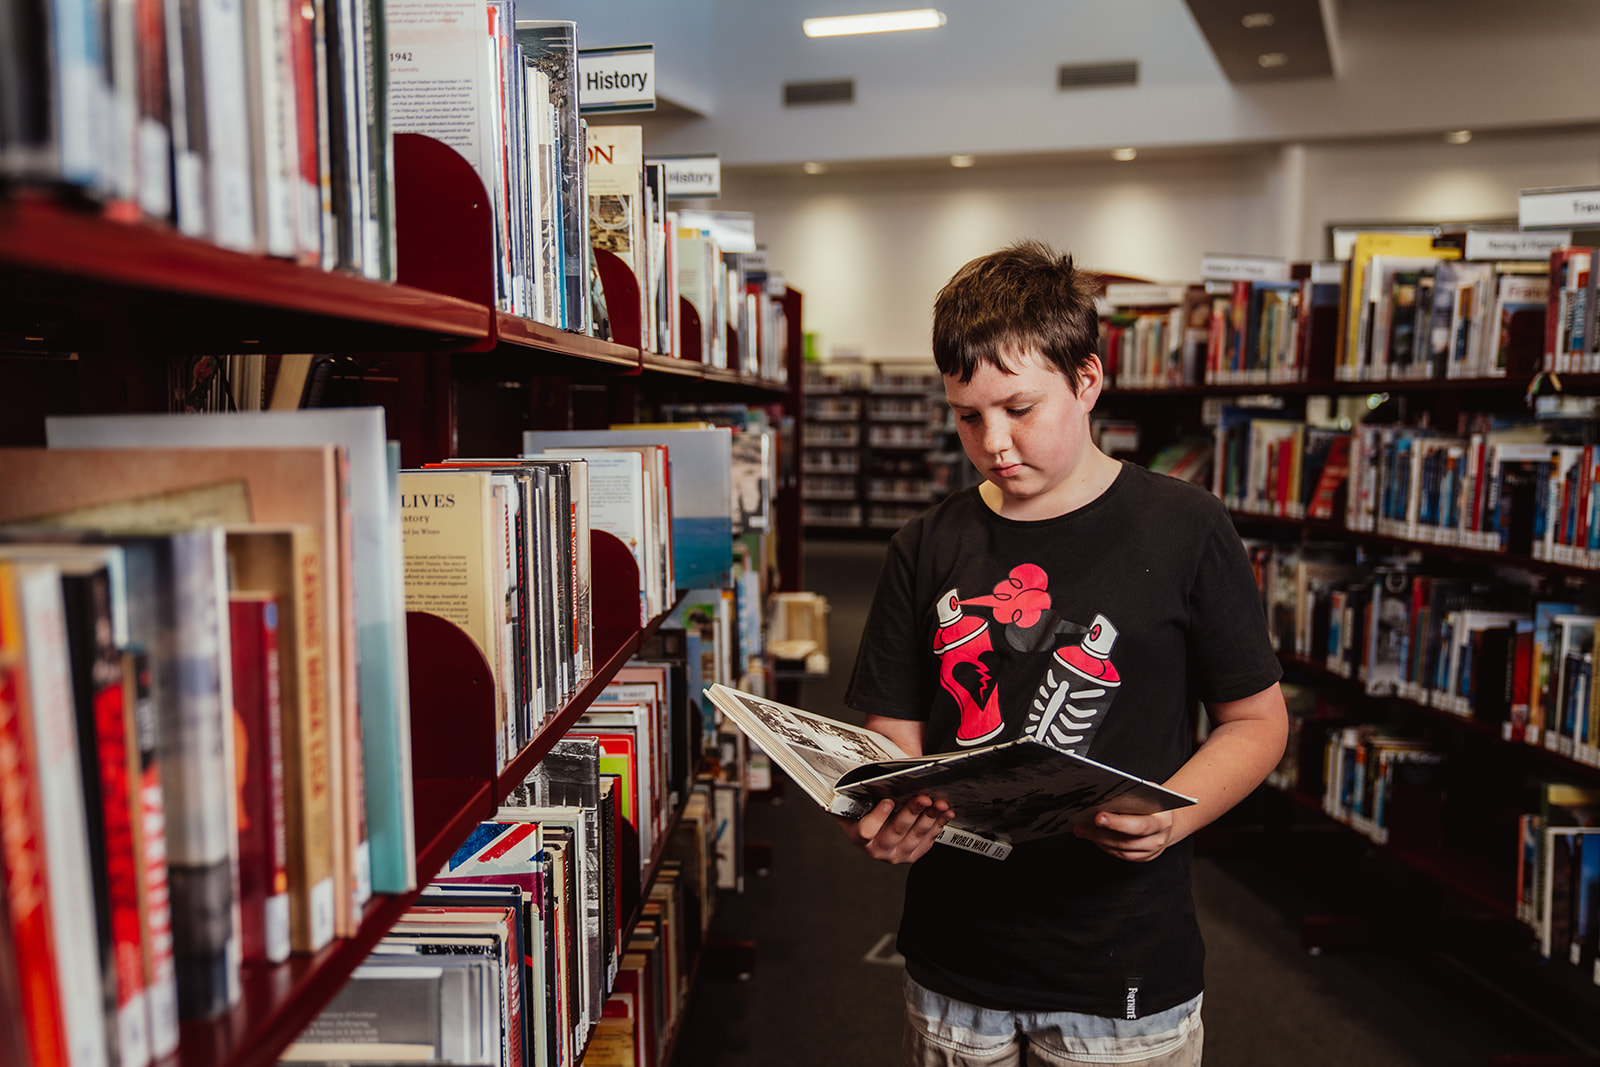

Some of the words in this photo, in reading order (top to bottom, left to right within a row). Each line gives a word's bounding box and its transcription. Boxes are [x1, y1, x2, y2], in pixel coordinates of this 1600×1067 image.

[390, 52, 413, 62] 1942
[587, 71, 648, 91] History
[669, 172, 714, 186] History
[401, 494, 456, 508] LIVES
[304, 552, 320, 650] SAVING
[306, 656, 324, 734] MONA
[310, 740, 328, 801] LISA
[950, 834, 974, 848] WORLD
[972, 840, 989, 852] WAR
